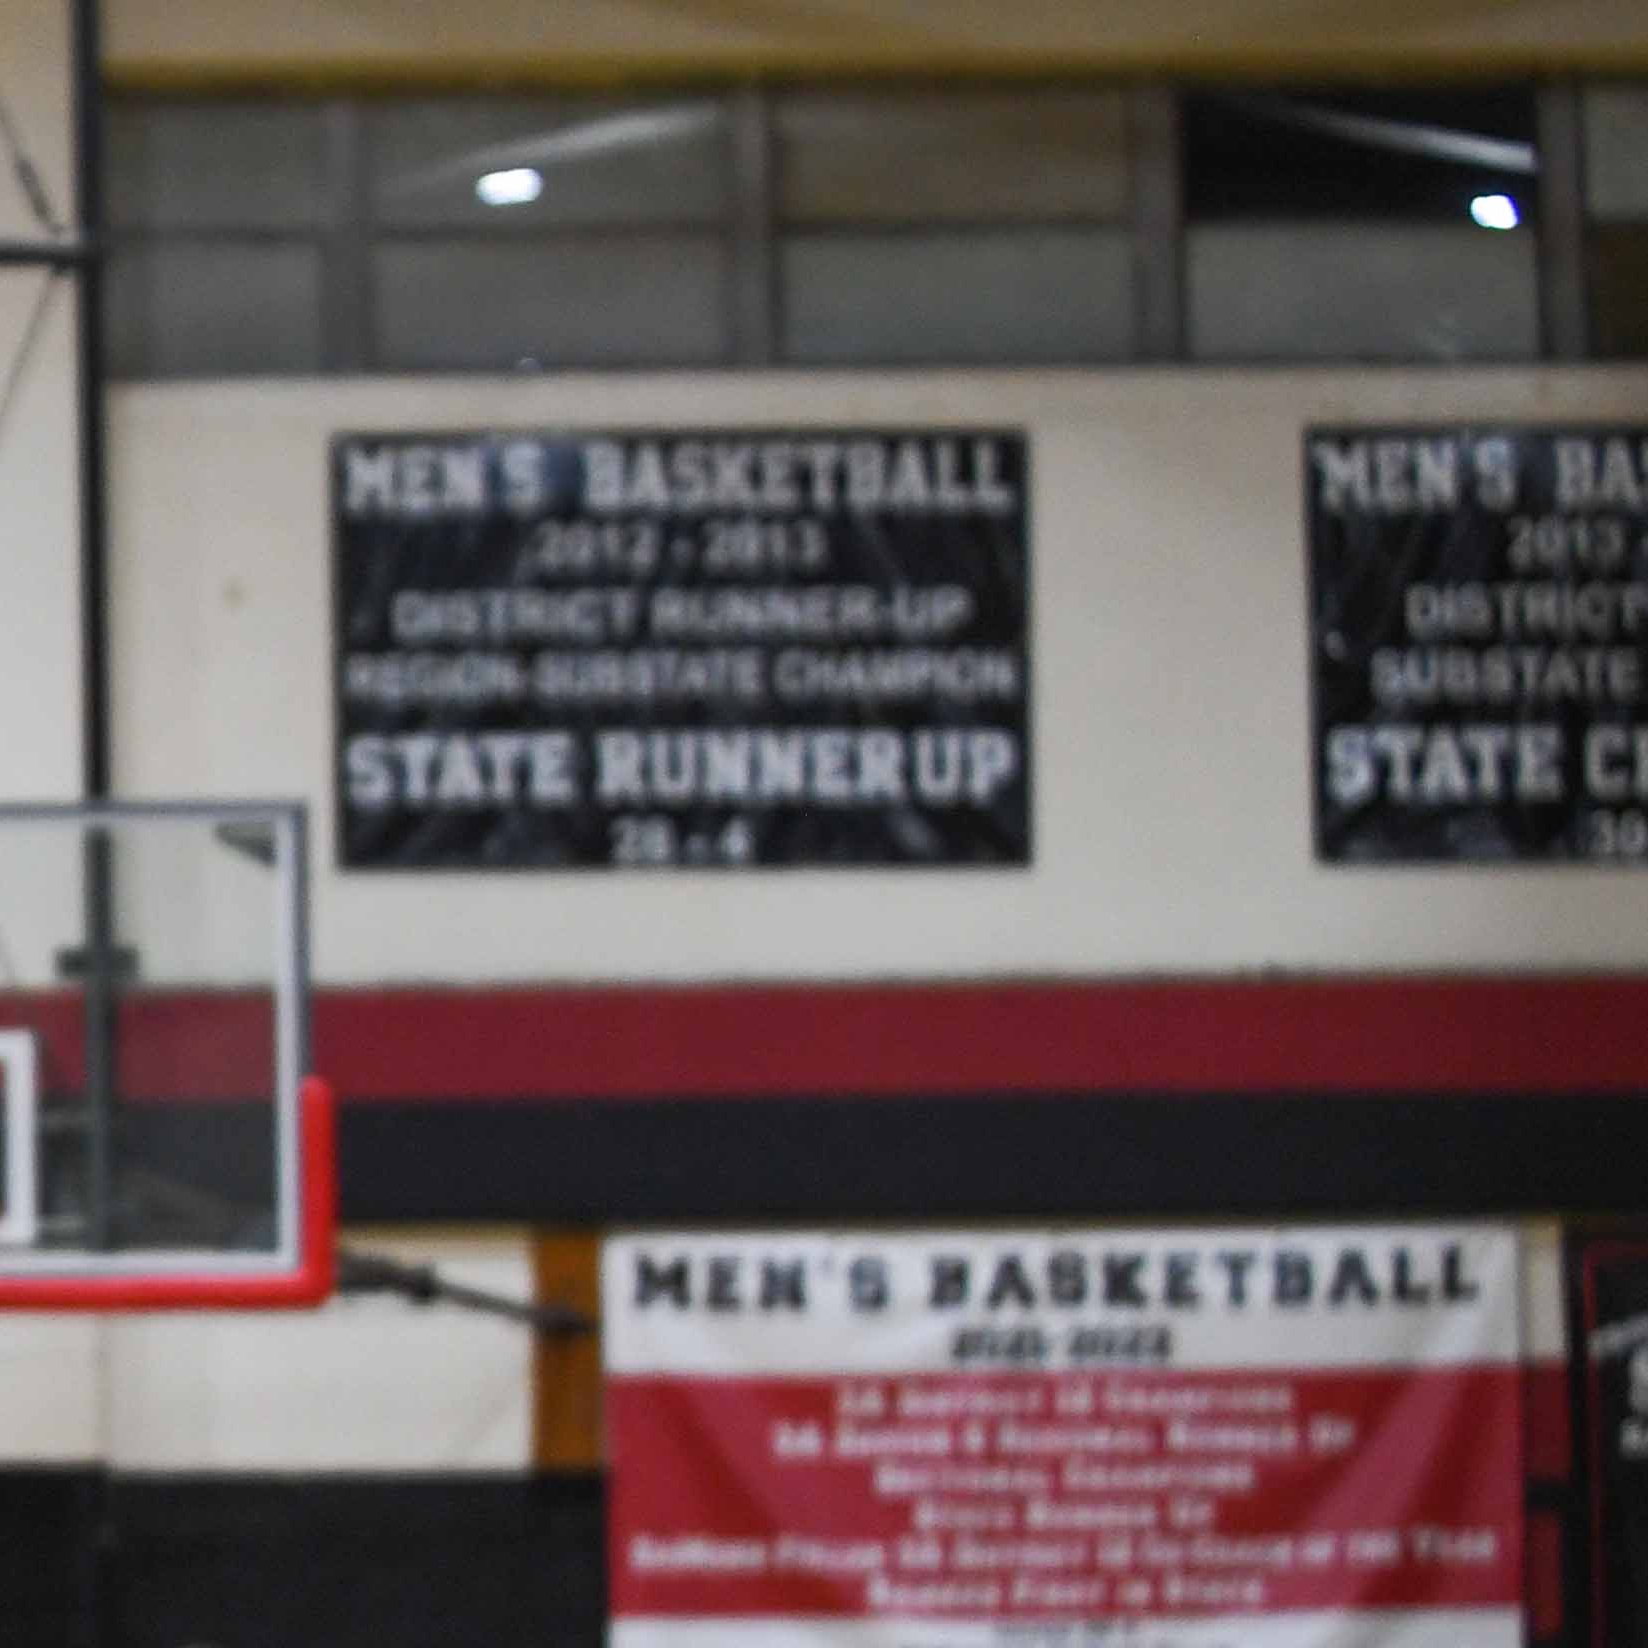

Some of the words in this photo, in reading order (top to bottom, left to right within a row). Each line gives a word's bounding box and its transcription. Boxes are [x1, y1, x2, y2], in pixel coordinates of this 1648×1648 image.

[582, 440, 1016, 511] BASKETBALL
[1556, 438, 1648, 507] BA
[346, 733, 574, 806] STATE
[1326, 723, 1562, 804] STATE
[632, 1251, 890, 1315] MEN'S
[927, 1242, 1481, 1311] BASKETBALL
